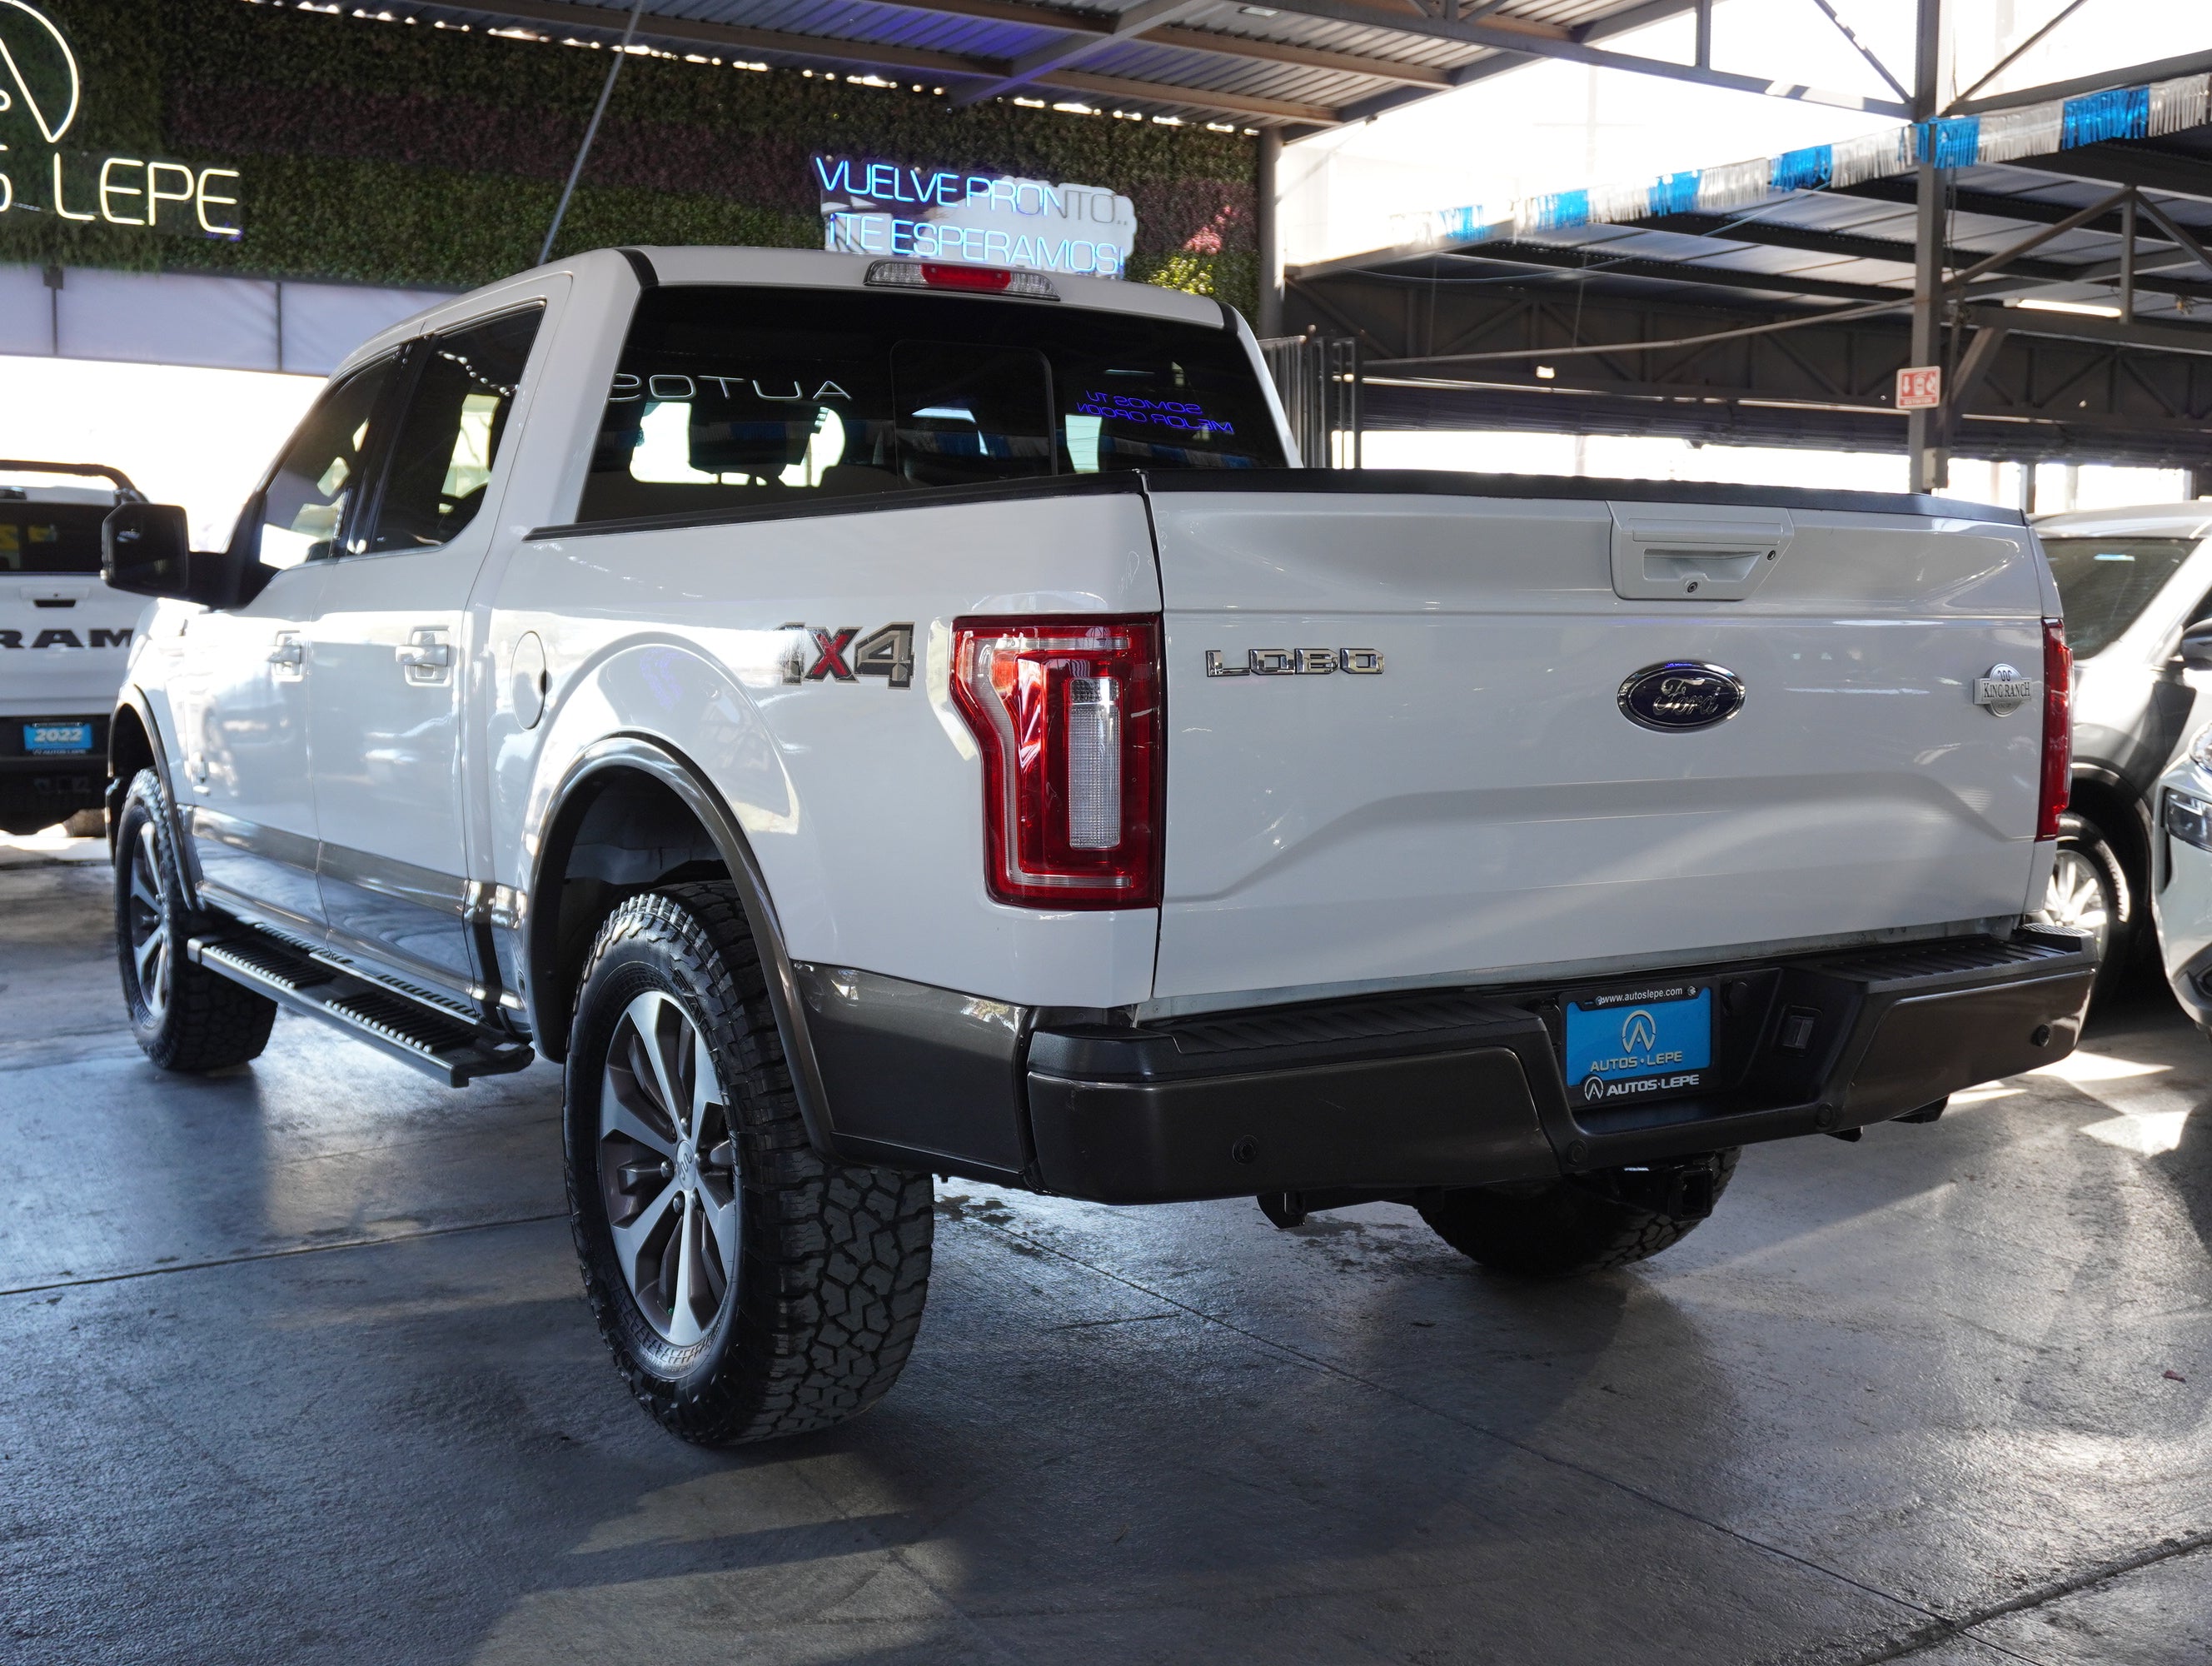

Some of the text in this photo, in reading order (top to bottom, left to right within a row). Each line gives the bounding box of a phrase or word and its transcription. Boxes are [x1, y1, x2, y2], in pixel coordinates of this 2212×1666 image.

[53, 152, 241, 235] LEPE
[815, 157, 959, 207] VUELVE
[891, 219, 1125, 277] ESPERAMOS!
[0, 628, 134, 649] RAM
[1205, 647, 1385, 677] LOBO
[1652, 676, 1721, 716] Ford
[1983, 681, 2030, 698] KING RANCH
[34, 727, 82, 742] 2022
[1599, 986, 1683, 1005] www.autoslepe.com
[1589, 1050, 1683, 1072] AUTOS LEPE
